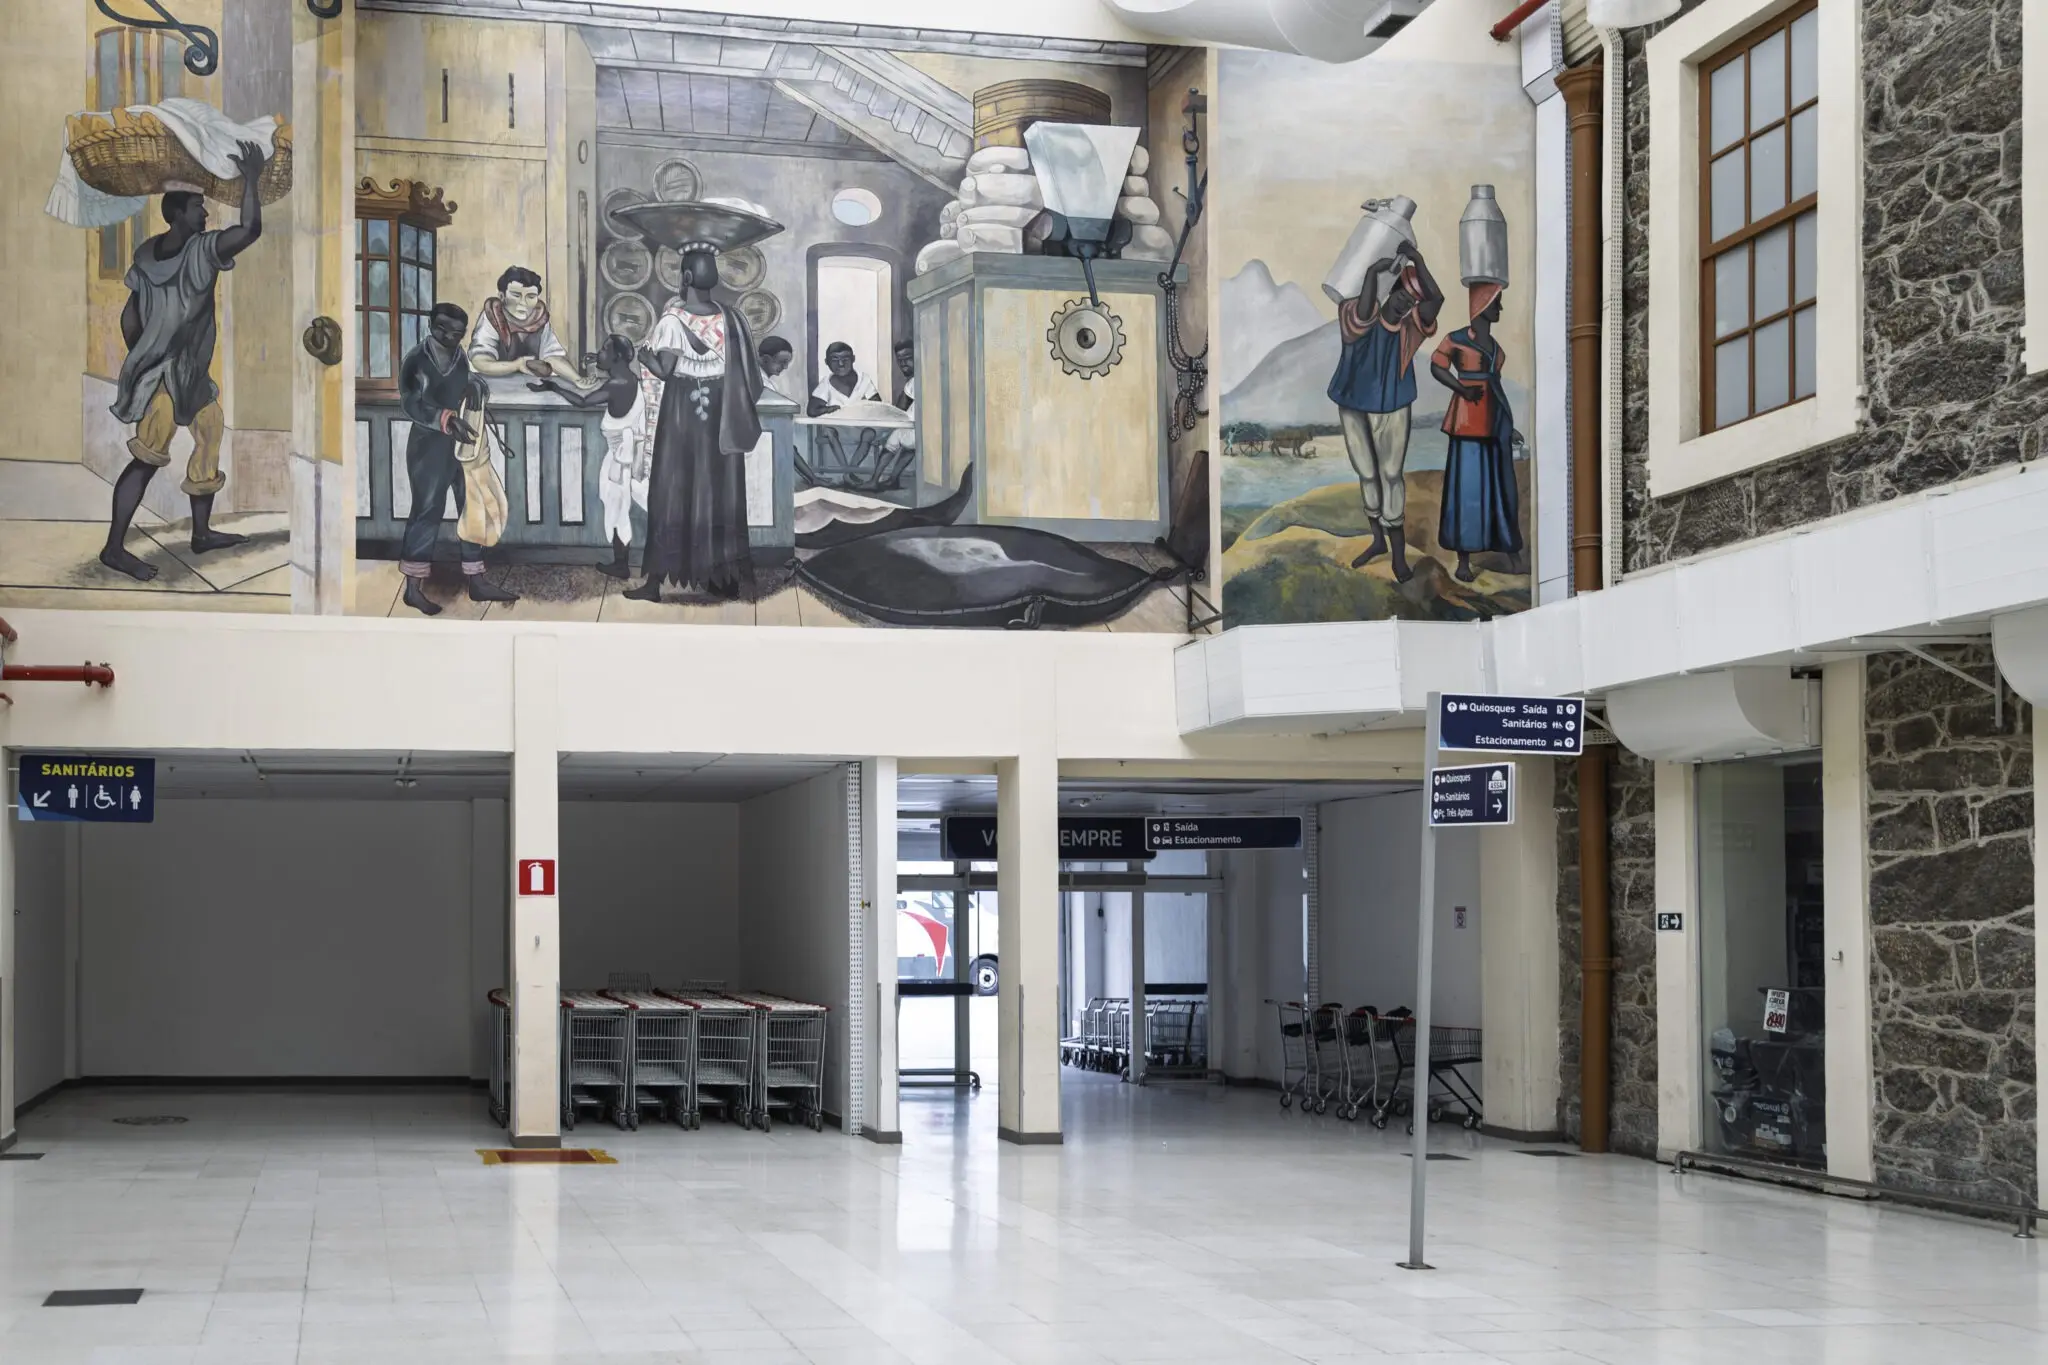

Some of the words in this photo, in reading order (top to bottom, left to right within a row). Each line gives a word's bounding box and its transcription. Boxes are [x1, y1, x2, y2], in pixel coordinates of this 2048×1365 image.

[1469, 702, 1516, 714] Quiosques
[1522, 704, 1548, 715] Saída
[1502, 718, 1548, 729] Sanitários
[1475, 735, 1547, 746] Estacionamento
[42, 761, 135, 778] SANITÁRIOS
[1446, 774, 1471, 784] Quiosques
[1445, 791, 1471, 801] Sanitários
[1446, 807, 1457, 817] Três
[1457, 808, 1474, 819] Apitos
[1174, 822, 1199, 832] Saída
[1060, 829, 1122, 847] EMPRE
[1174, 835, 1242, 845] Estacionamento
